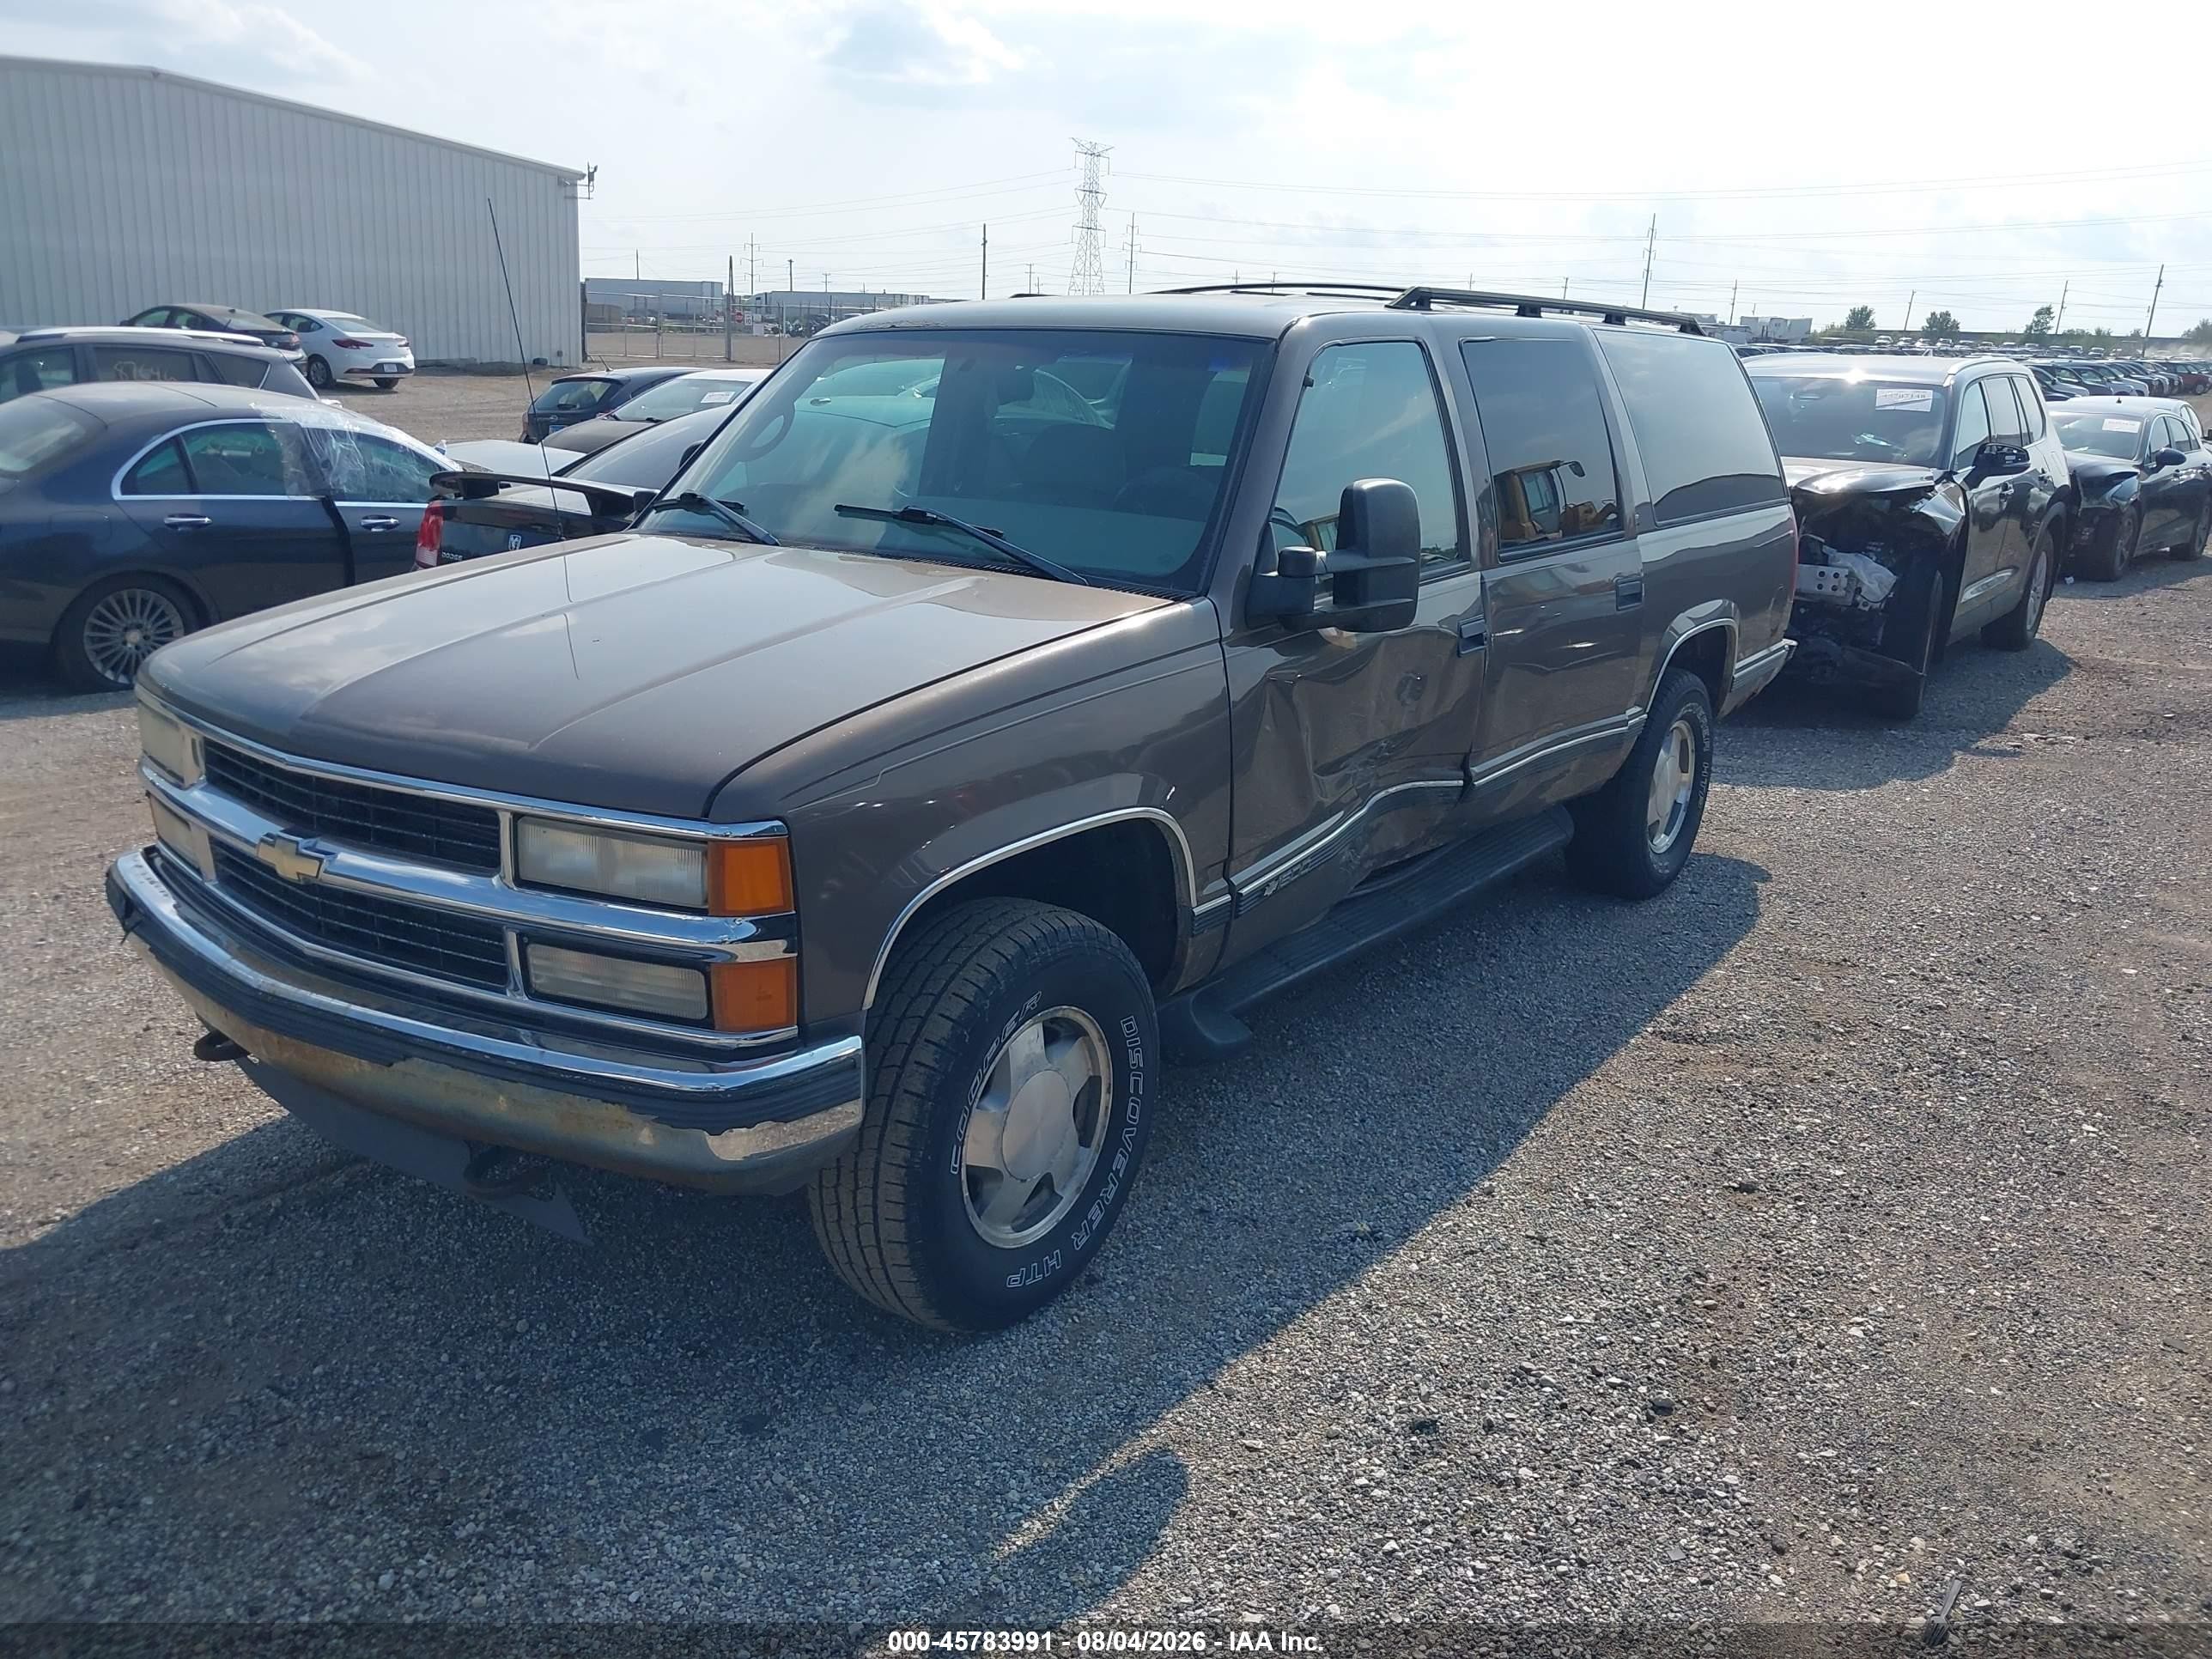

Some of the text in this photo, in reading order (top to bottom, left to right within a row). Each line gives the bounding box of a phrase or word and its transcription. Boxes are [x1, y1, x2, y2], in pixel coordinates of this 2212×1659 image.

[950, 990, 1042, 1176] COOPER
[1006, 1015, 1145, 1289] DISCOVERER HTP
